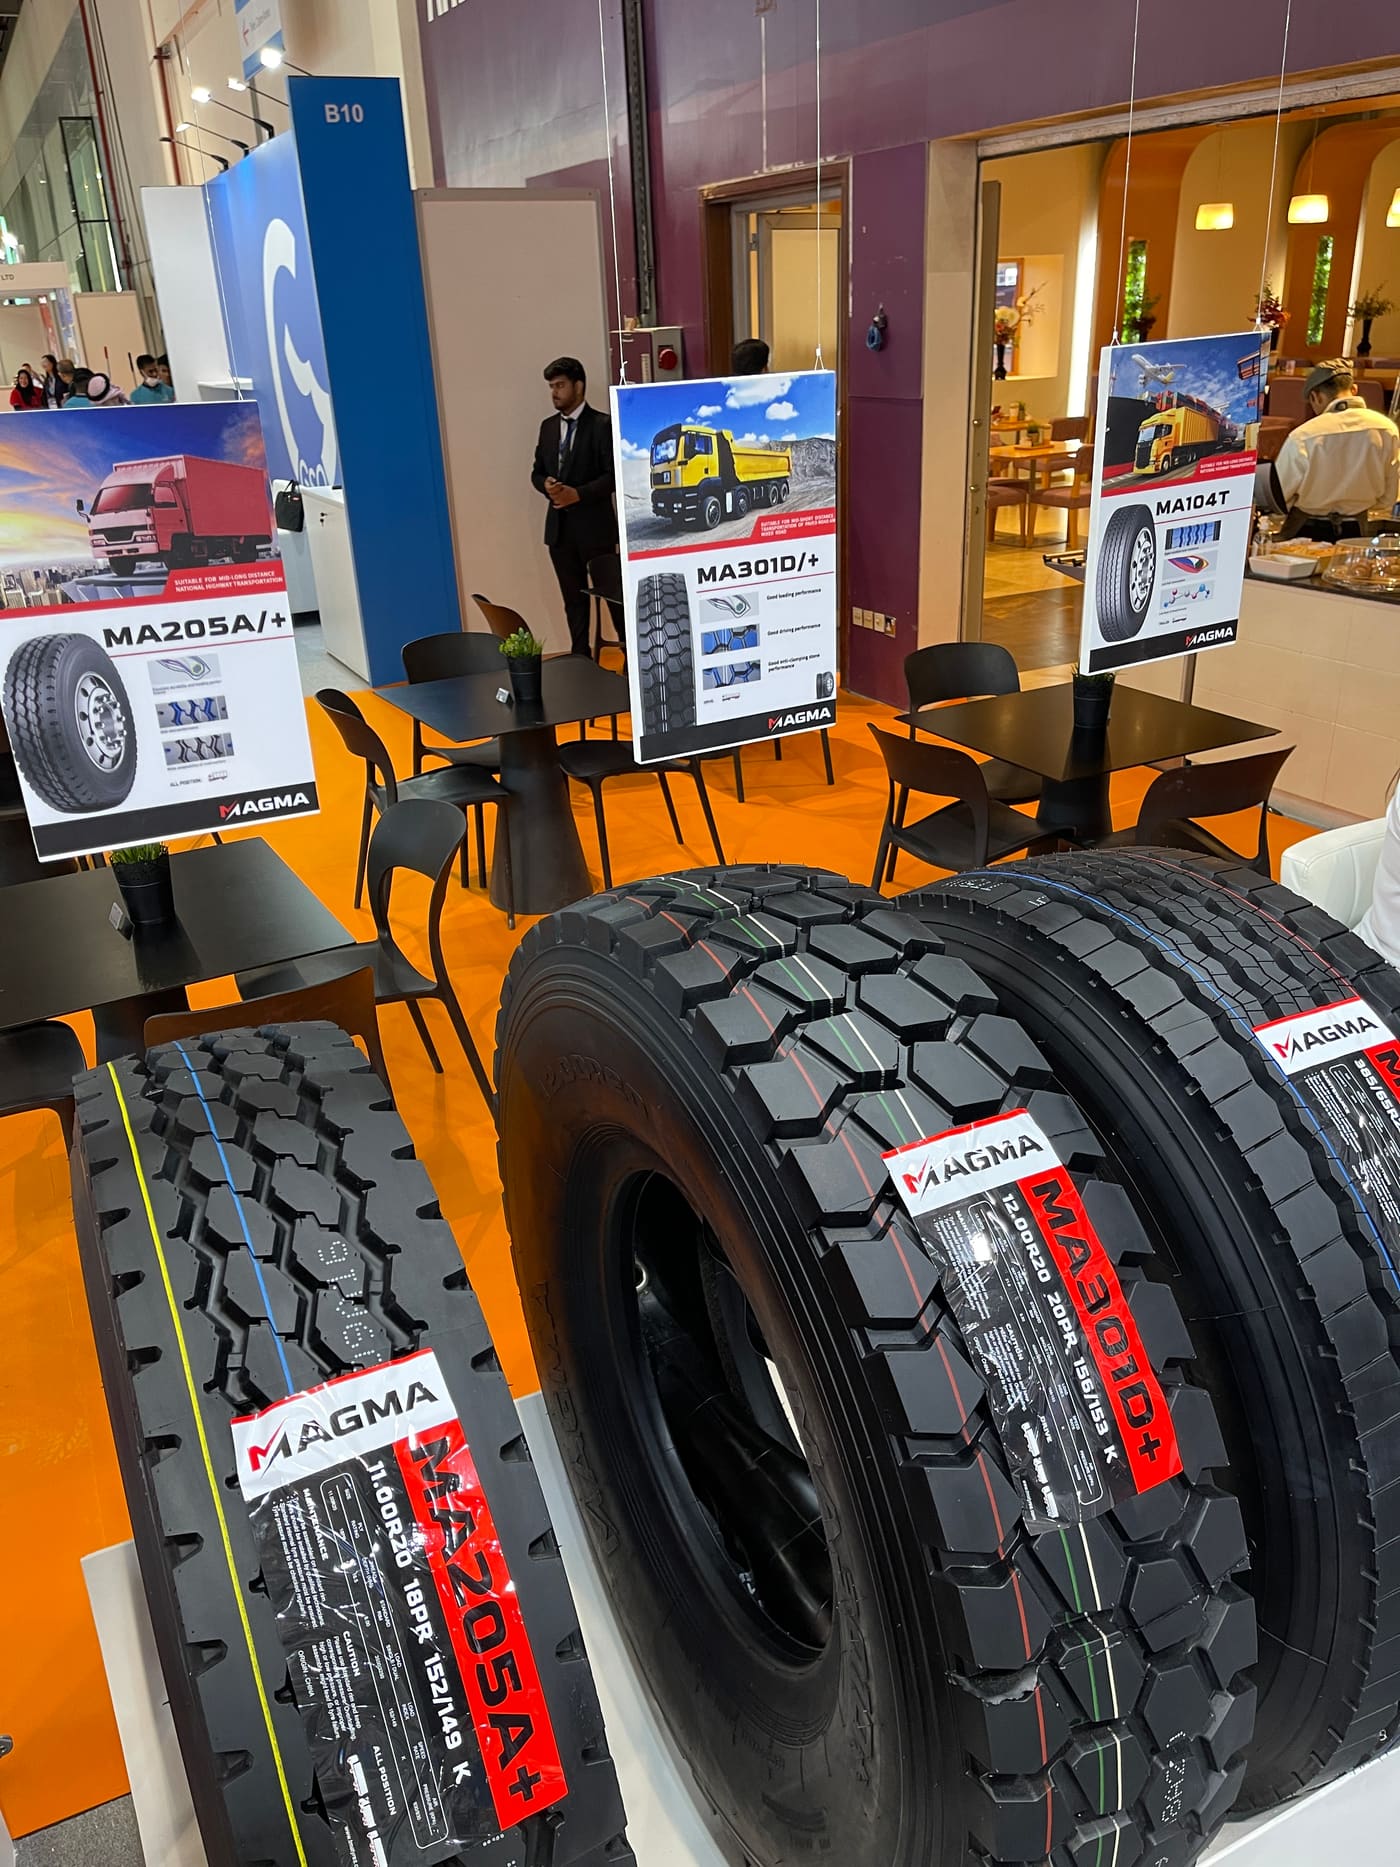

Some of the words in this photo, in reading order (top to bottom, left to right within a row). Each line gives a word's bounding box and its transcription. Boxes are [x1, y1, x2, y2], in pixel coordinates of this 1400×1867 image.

[324, 103, 364, 123] B10
[1156, 491, 1230, 516] MA104T
[174, 578, 202, 586] SUITABLE
[218, 573, 247, 582] MID-LONG
[247, 570, 275, 579] DISTANCE
[175, 584, 205, 593] NATIONAL
[206, 582, 232, 590] HIGHWAY
[233, 577, 283, 586] TRANSPORTATION
[697, 552, 819, 584] MA301D/+
[795, 588, 822, 597] performance
[103, 611, 287, 648] MA205A/+
[794, 623, 821, 632] performance
[1185, 626, 1233, 648] MAGMA
[768, 707, 831, 732] MAGMA
[219, 792, 310, 822] MAGMA
[1273, 1016, 1379, 1064] MAGMA
[902, 1134, 1044, 1200] MAGMA
[1001, 1191, 1051, 1284] 12.00R20
[1044, 1290, 1080, 1349] 20PR
[1069, 1356, 1110, 1437] 156/153
[1100, 1444, 1119, 1464] K
[1031, 1179, 1161, 1463] MA301D+
[1005, 1322, 1024, 1360] CAUTION
[247, 1381, 439, 1479] MAGMA
[1038, 1415, 1052, 1443] DRIVE
[302, 1487, 329, 1560] MAINTENANCE
[364, 1460, 413, 1568] 11.00R20
[399, 1577, 435, 1644] 18PR
[419, 1652, 465, 1750] 152/149
[450, 1760, 473, 1785] K
[412, 1436, 542, 1801] MA205A+
[341, 1630, 361, 1677] CAUTION
[296, 1649, 309, 1674] ORIGIN
[303, 1676, 315, 1697] CHINA
[371, 1744, 384, 1766] ALL
[377, 1765, 397, 1816] POSITION
